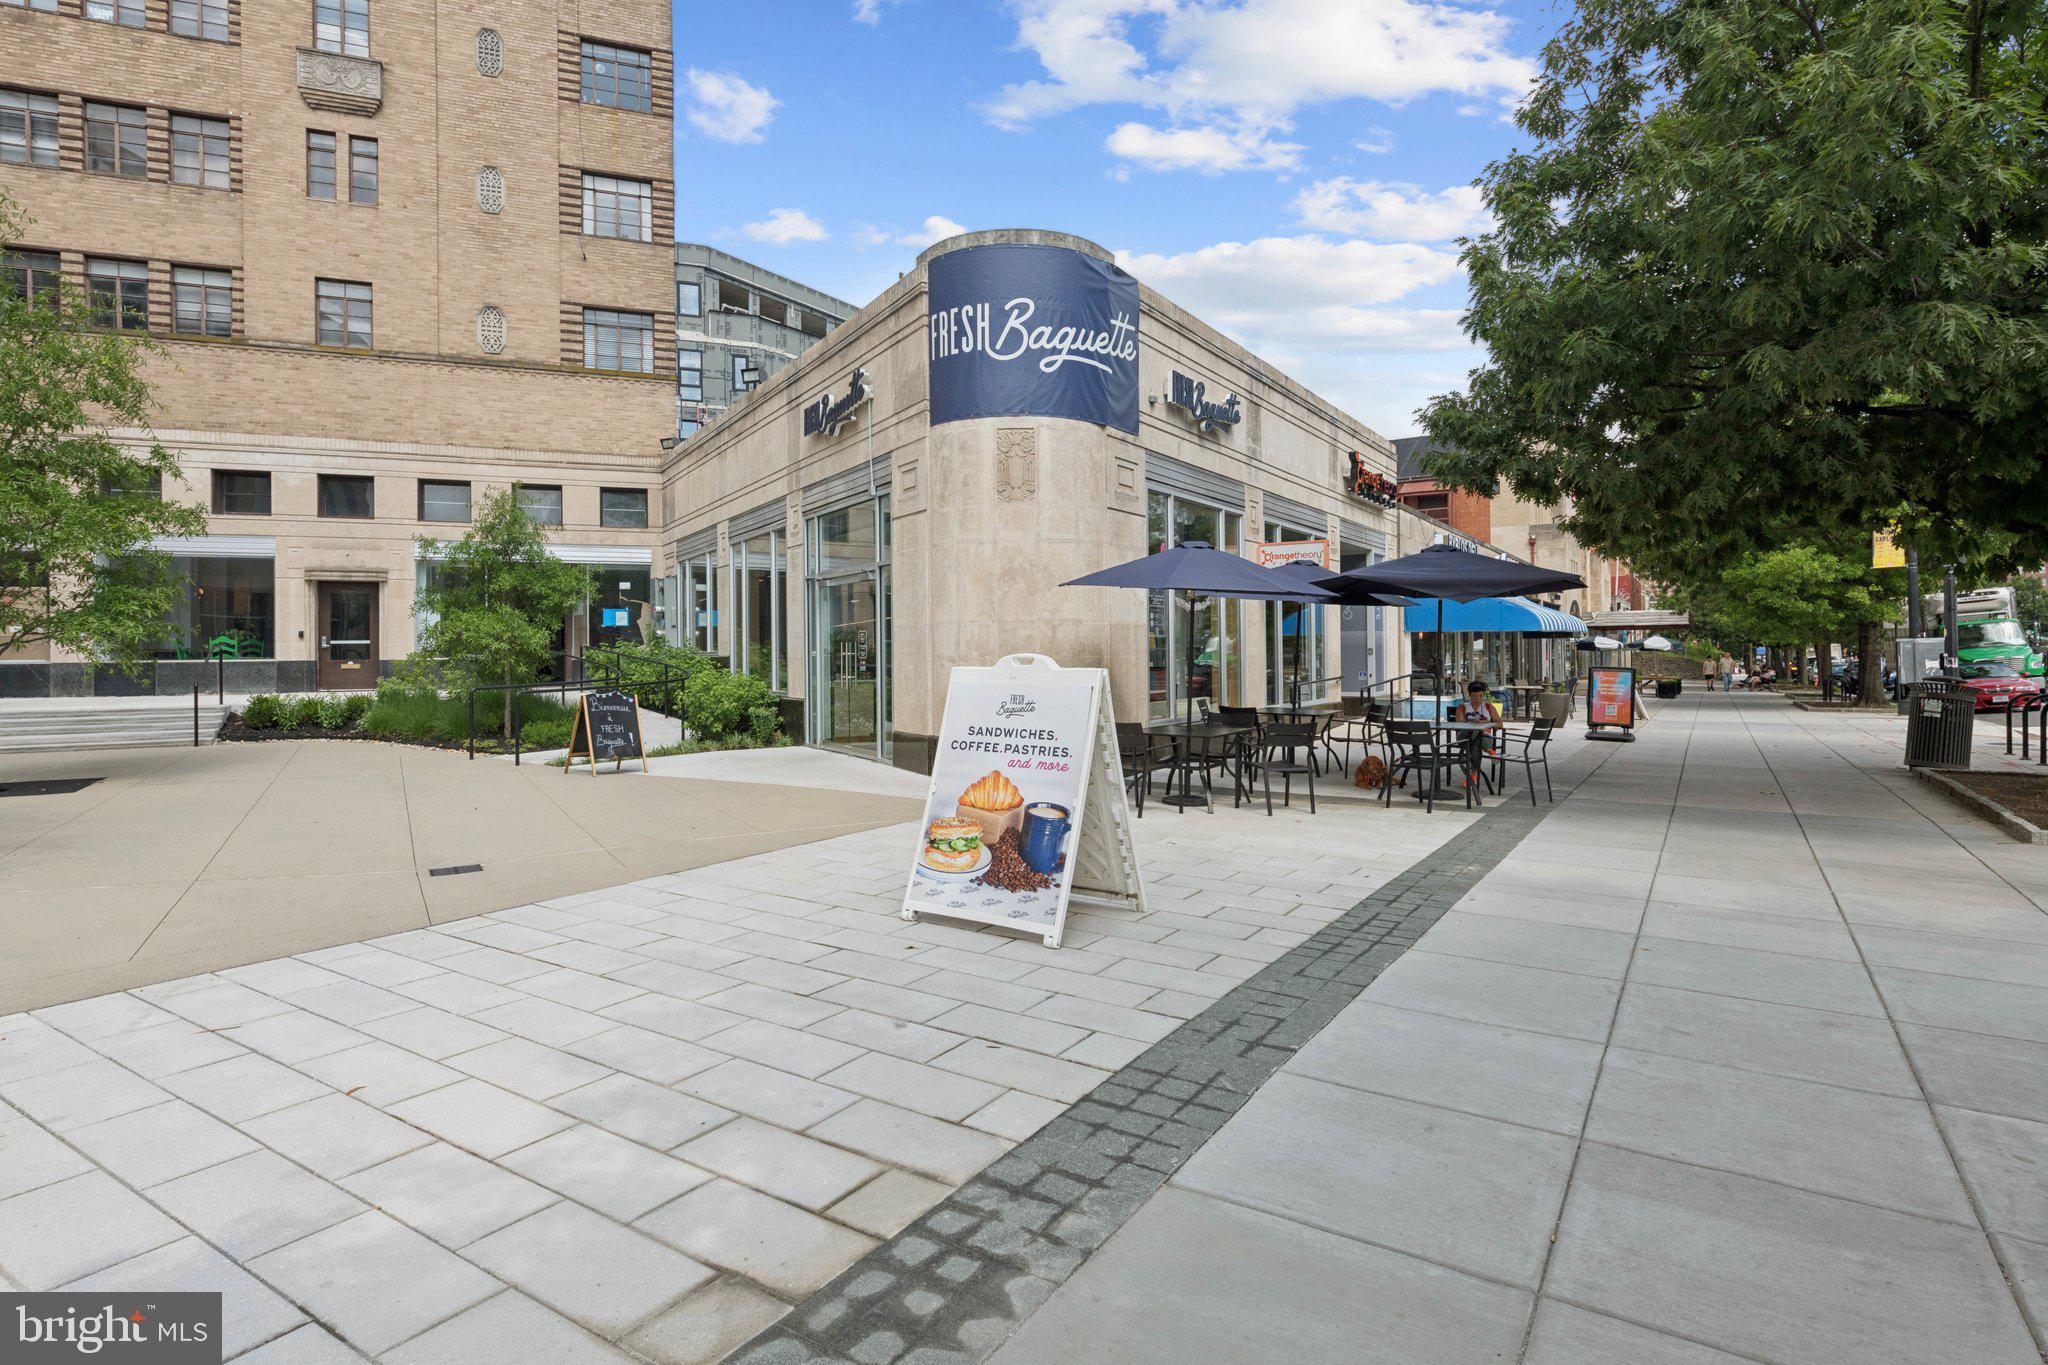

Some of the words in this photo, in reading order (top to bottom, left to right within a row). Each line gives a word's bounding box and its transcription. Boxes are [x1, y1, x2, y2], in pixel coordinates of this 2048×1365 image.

[931, 302, 990, 361] FRESH
[994, 297, 1137, 374] Baguette
[1262, 550, 1322, 564] Orangetheory
[1009, 694, 1026, 706] FRESH
[996, 700, 1037, 719] Baguette
[601, 724, 624, 734] FRESH
[967, 725, 1059, 741] SANDWICHES.
[1007, 757, 1032, 769] and
[1036, 760, 1070, 772] more
